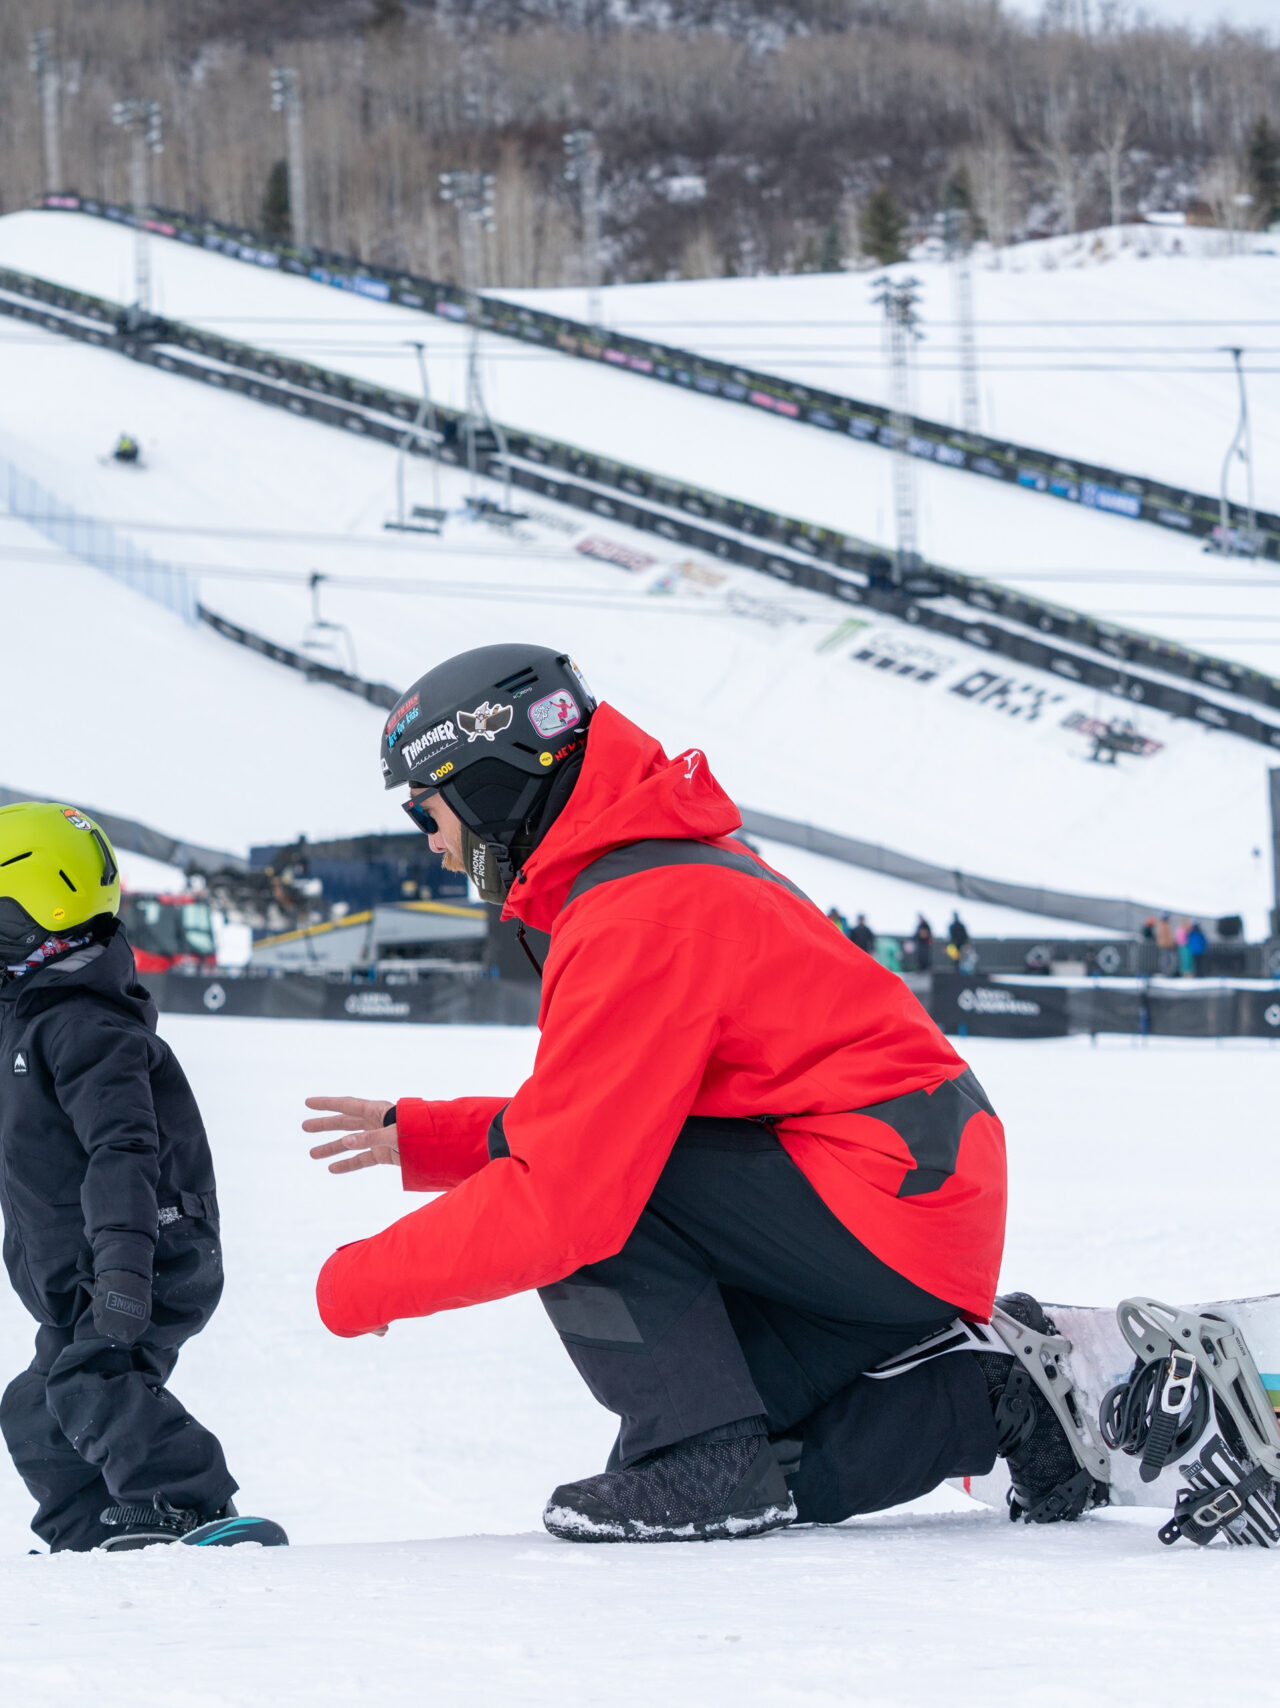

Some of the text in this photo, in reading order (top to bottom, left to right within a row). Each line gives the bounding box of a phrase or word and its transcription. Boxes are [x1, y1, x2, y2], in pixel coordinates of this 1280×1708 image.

[405, 706, 419, 725] kids
[401, 720, 457, 769] THRASHER
[429, 761, 454, 782] DOOD
[472, 848, 480, 876] MONS
[478, 842, 486, 878] ROYALE
[110, 1295, 144, 1316] DAKINE
